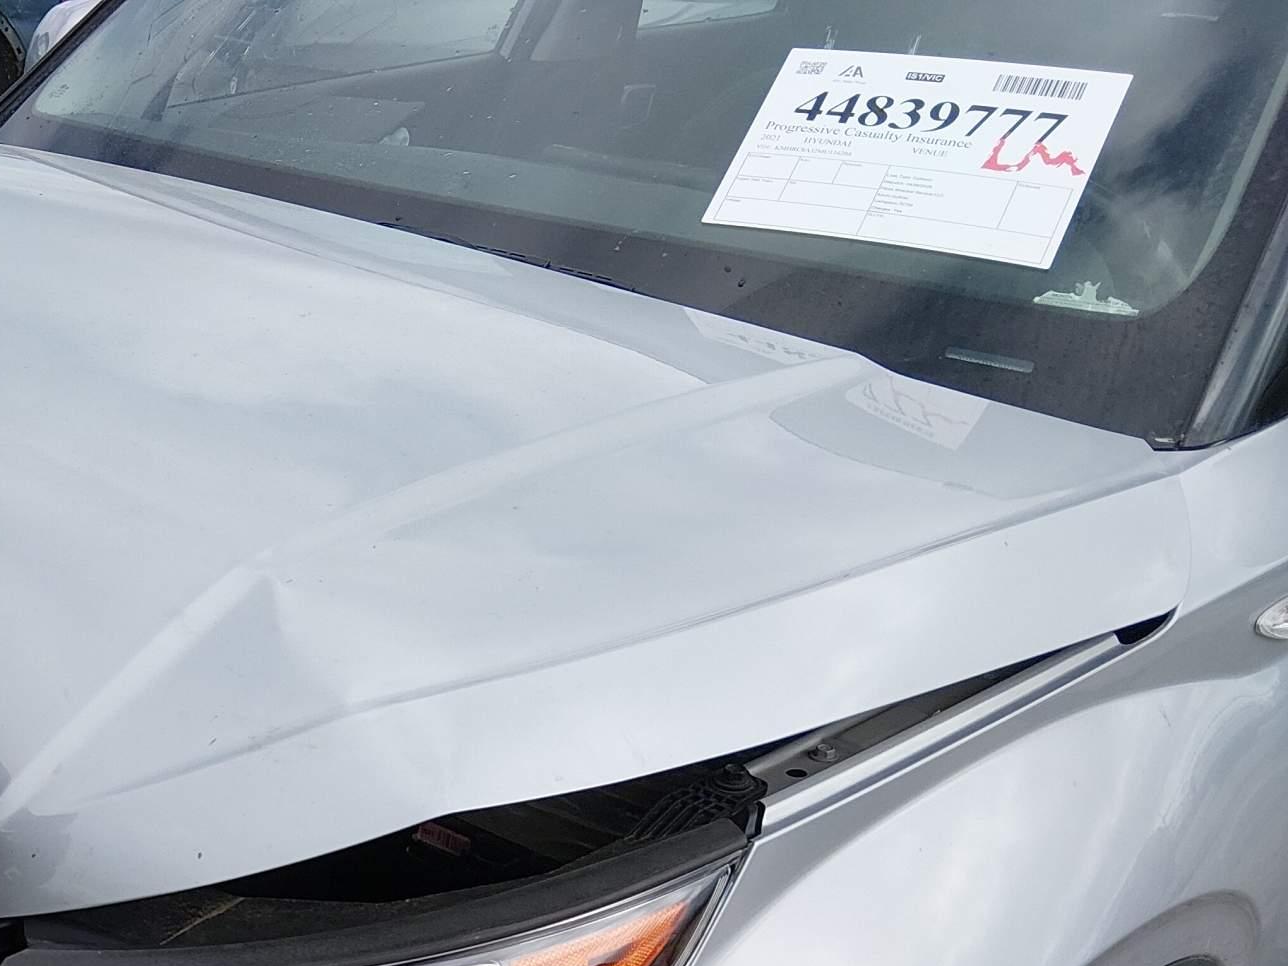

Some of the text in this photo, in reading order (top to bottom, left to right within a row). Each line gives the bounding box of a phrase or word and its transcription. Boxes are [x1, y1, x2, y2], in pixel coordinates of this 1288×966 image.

[794, 90, 1069, 145] 44839777
[765, 120, 973, 149] Progressive Casualty Insurance
[803, 137, 853, 148] HYUNDAI
[912, 147, 949, 158] VENUE
